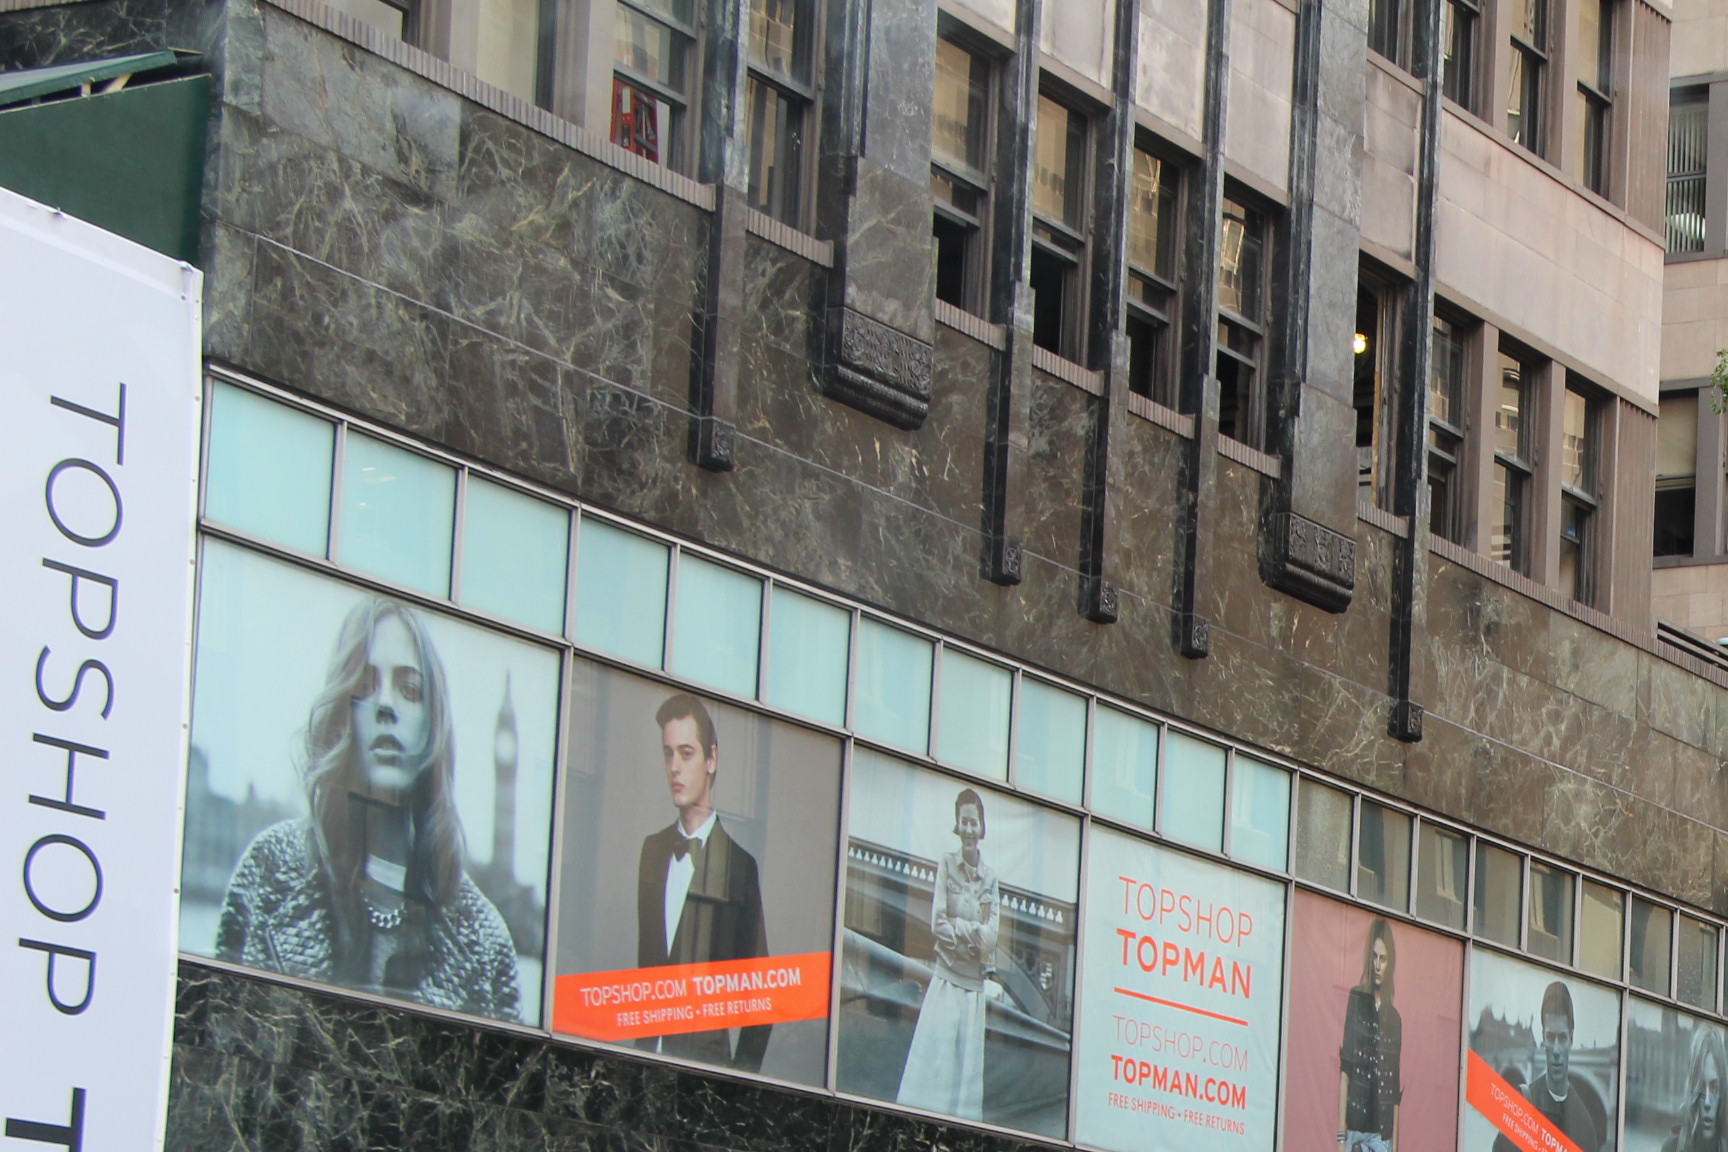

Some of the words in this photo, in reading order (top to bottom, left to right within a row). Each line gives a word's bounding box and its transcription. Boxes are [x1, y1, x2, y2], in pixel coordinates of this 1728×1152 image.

[18, 382, 127, 1016] TOPSHOP
[1118, 875, 1253, 948] TOPSHOP
[581, 979, 687, 1008] TOPSHOP.COM
[692, 967, 801, 996] TOPMAN.COM
[1116, 928, 1253, 1000] TOPMAN
[616, 1011, 641, 1027] FREE
[643, 1005, 694, 1024] SHIPPING
[702, 1002, 725, 1017] FREE
[727, 997, 772, 1014] RETURNS
[1112, 1014, 1249, 1073] TOPSHOP.COM
[1110, 1054, 1247, 1110] TOPMAN.COM
[1490, 1082, 1540, 1135] TOPSHOP.COM
[1108, 1092, 1129, 1111] FREE
[1131, 1097, 1176, 1120] SHIPPING
[1183, 1109, 1204, 1127] FREE
[1205, 1113, 1245, 1136] RETURNS
[1502, 1113, 1515, 1129] FREE
